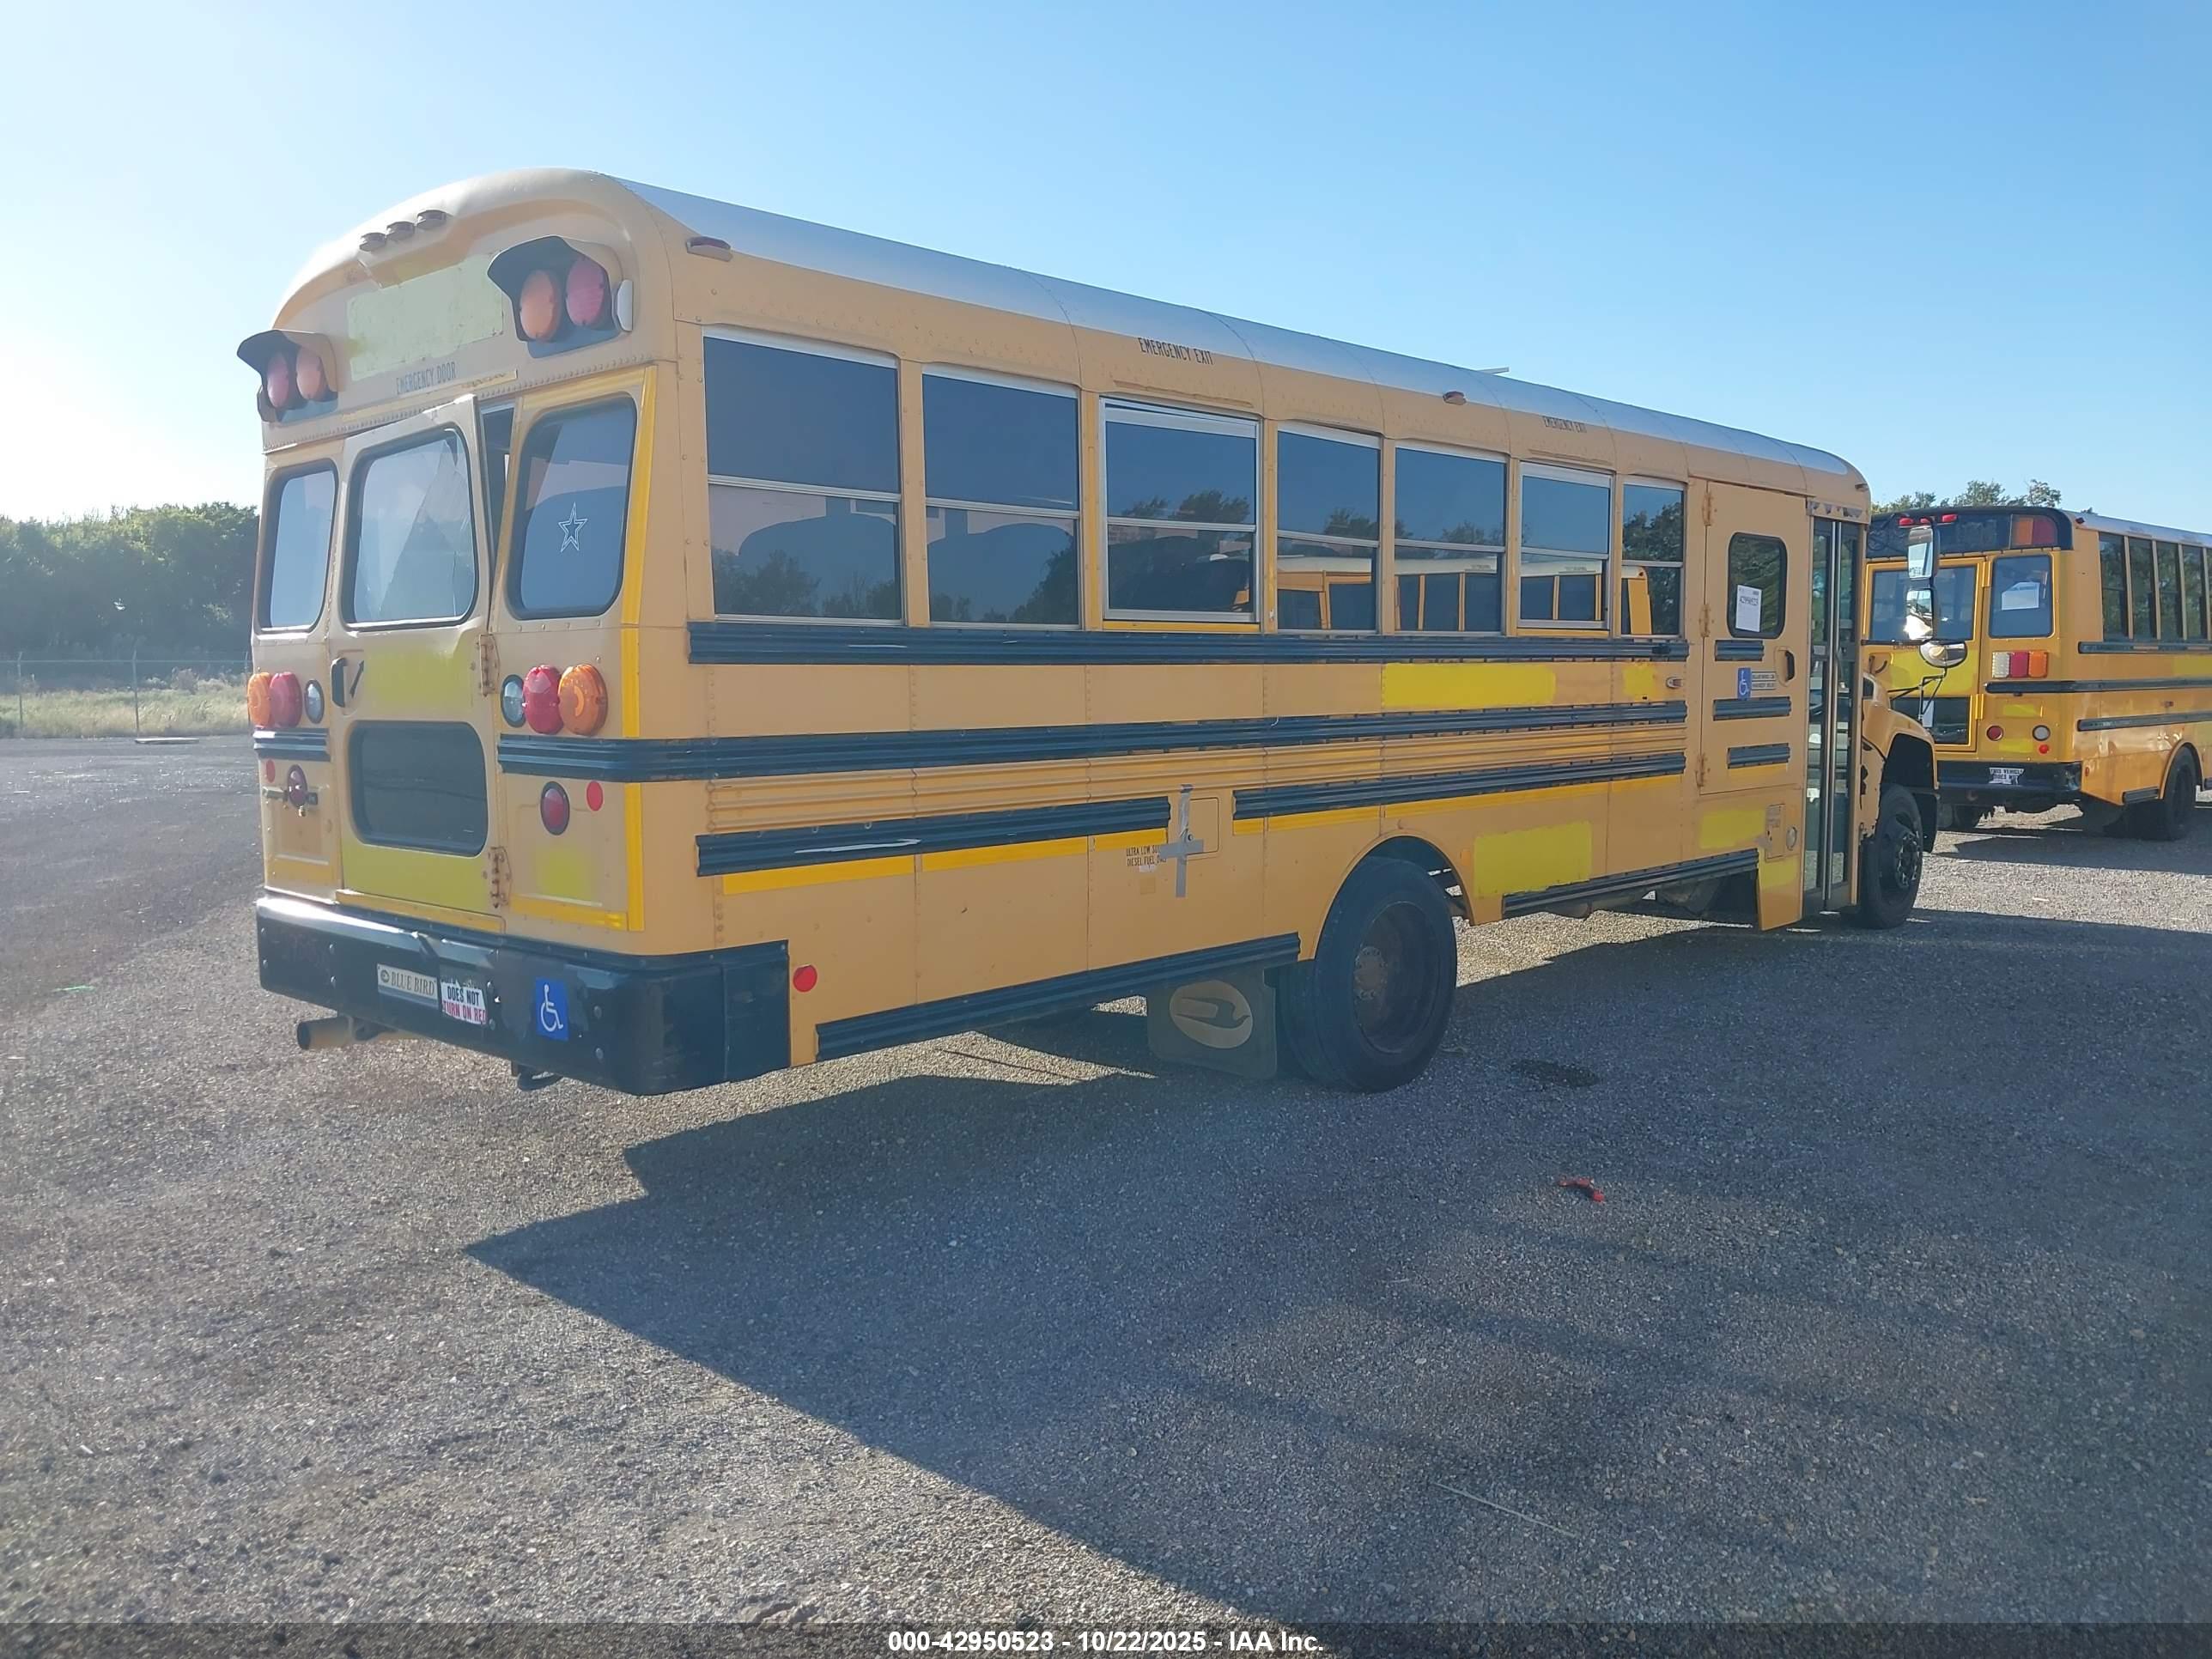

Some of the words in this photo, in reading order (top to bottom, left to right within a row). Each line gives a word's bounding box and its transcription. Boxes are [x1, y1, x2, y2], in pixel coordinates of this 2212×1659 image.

[1138, 337, 1192, 361] EMERGENCY
[1193, 348, 1214, 365] EXIT
[396, 368, 434, 395] EMERGENCY
[437, 361, 457, 384] DOOR
[1541, 416, 1575, 432] EMERGENCY
[1574, 421, 1587, 434] EXIT
[1126, 846, 1140, 857] ULTRA
[1141, 845, 1151, 855] LOW
[1127, 857, 1143, 866] DIESEL
[1144, 855, 1155, 866] FUEL
[391, 971, 412, 990] BLUE
[414, 977, 434, 996] BIRD
[447, 986, 465, 1003] DOES
[466, 989, 480, 1006] NOT
[442, 1000, 460, 1018] TURN
[462, 1005, 472, 1020] ON
